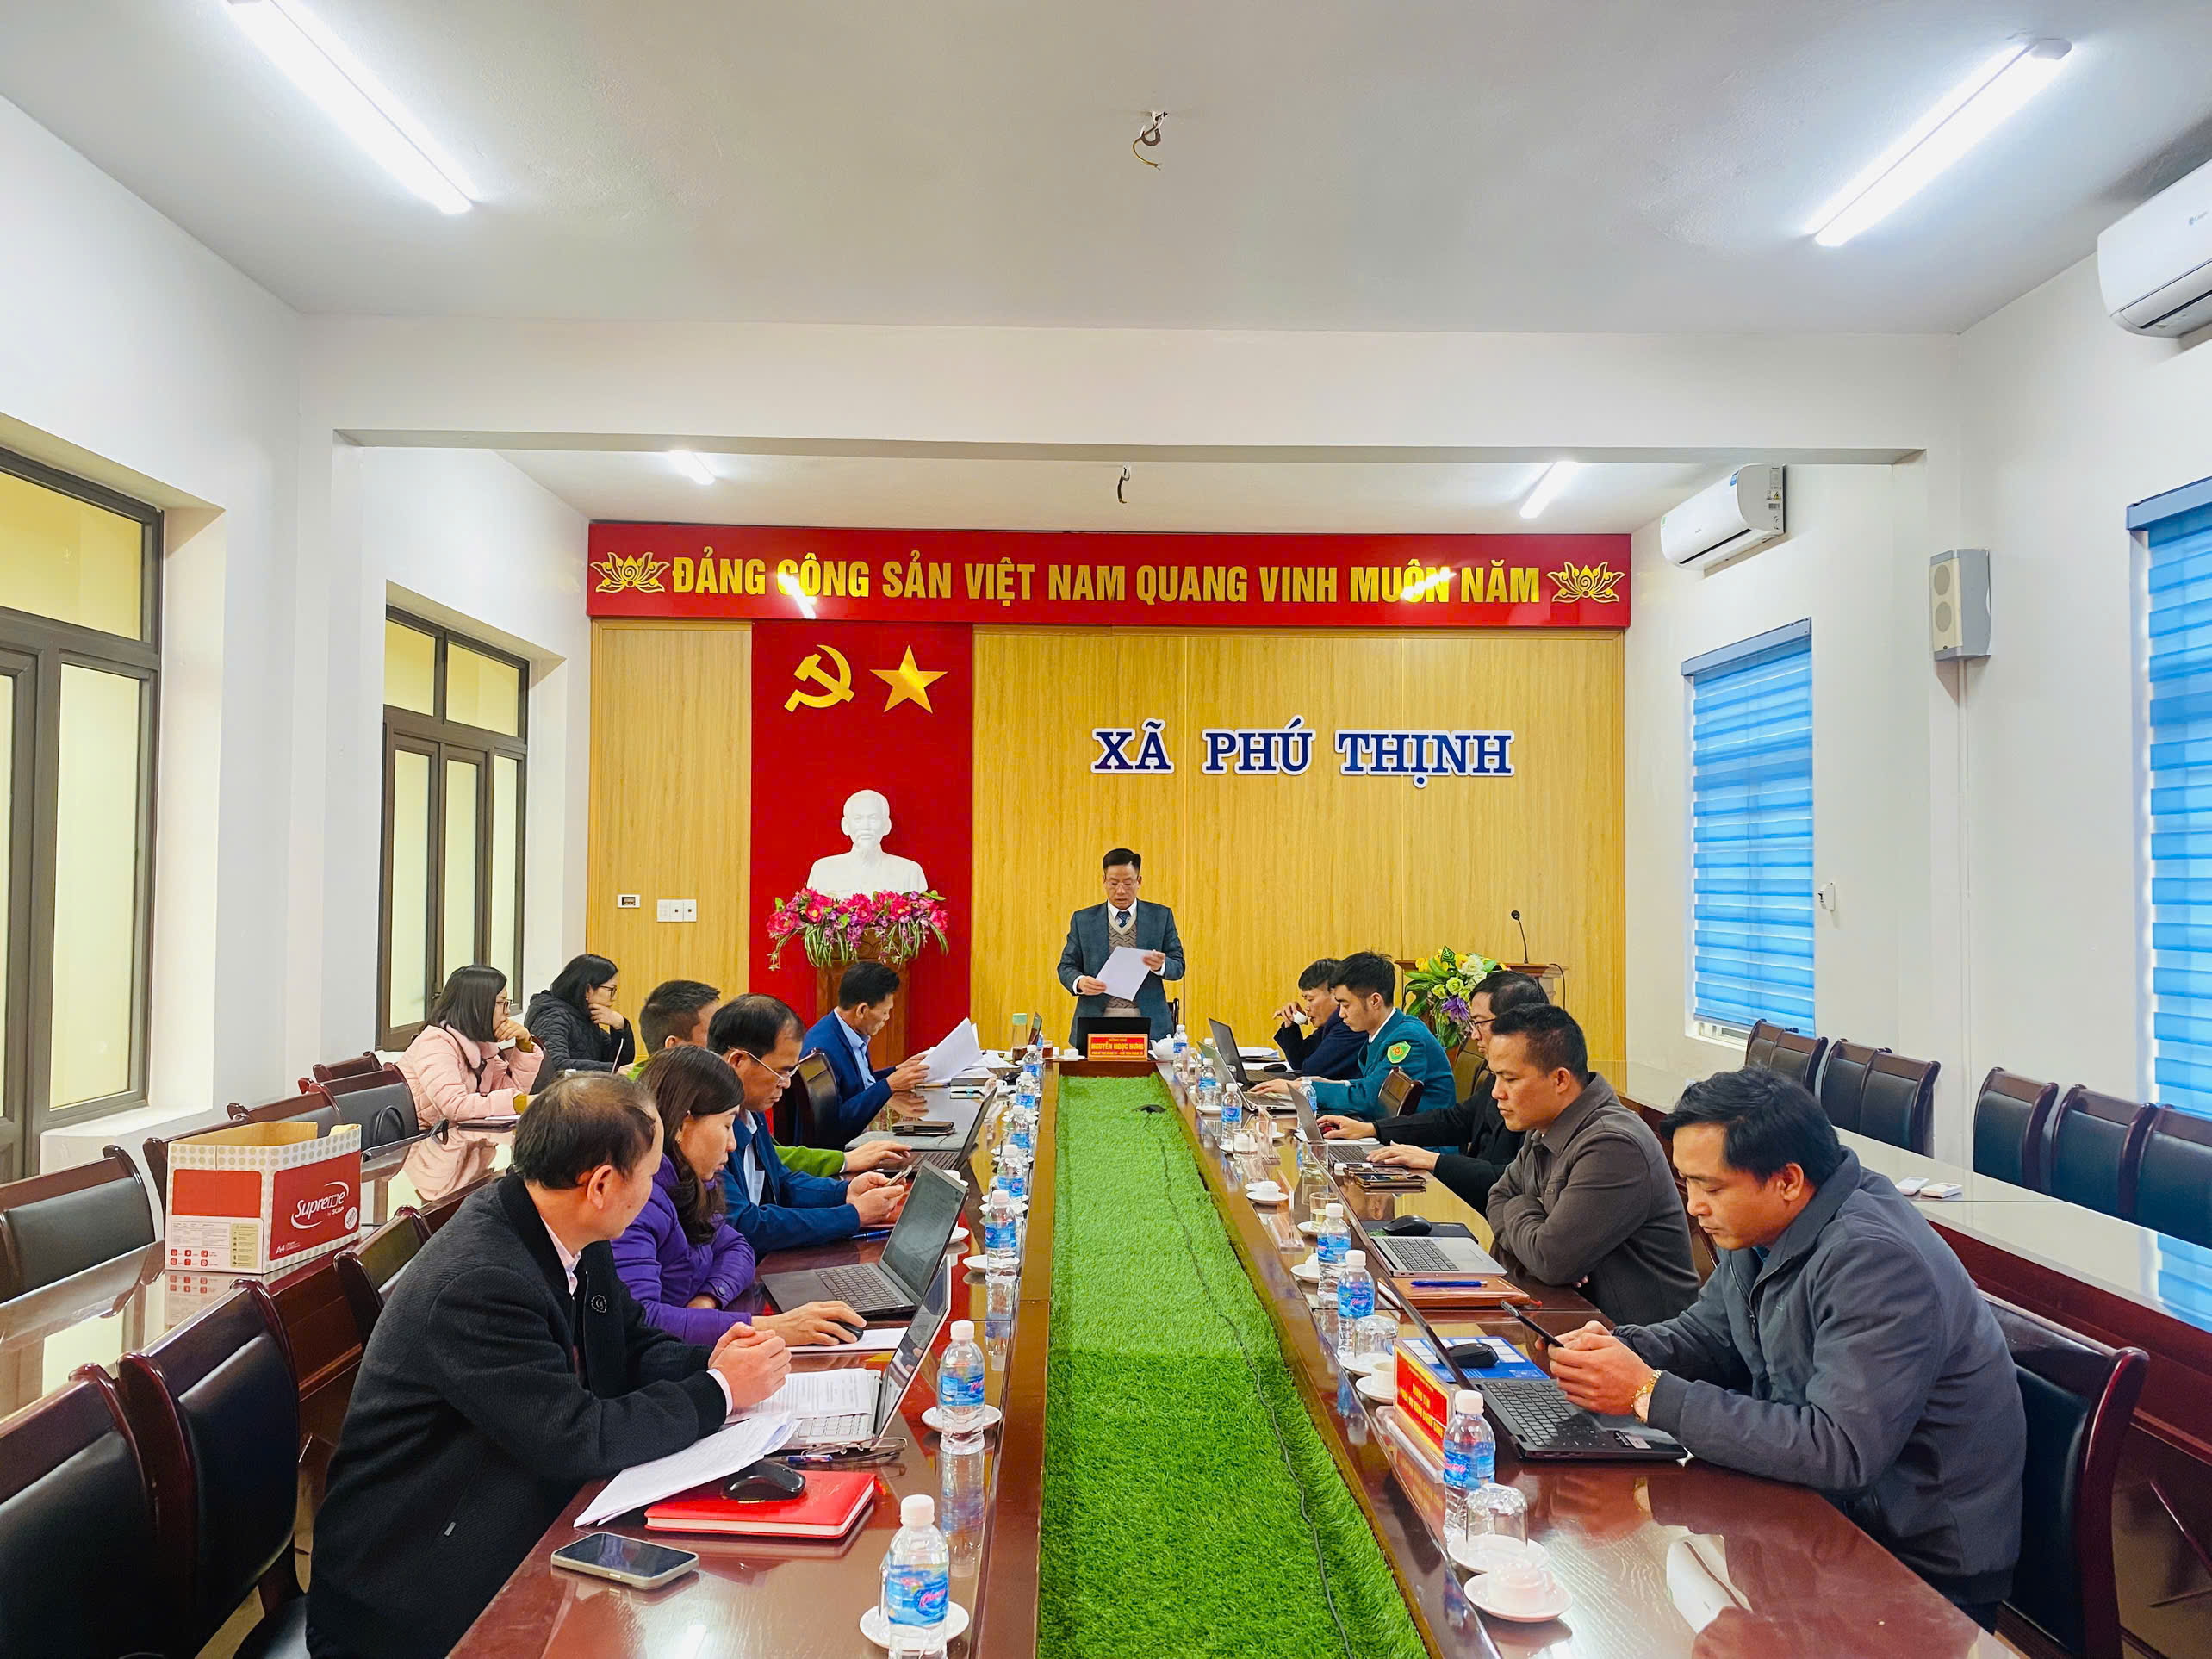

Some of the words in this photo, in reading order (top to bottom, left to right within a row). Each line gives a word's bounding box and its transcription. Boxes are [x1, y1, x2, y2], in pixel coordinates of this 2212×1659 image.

[672, 546, 765, 595] ĐẢNG
[882, 550, 952, 598] SẢN
[964, 557, 1035, 606] VIỆT
[1048, 564, 1125, 600] NAM
[1136, 565, 1248, 605] QUANG
[1260, 566, 1338, 602] VINH
[1350, 558, 1451, 603] MUÔN
[1460, 559, 1540, 603] NĂM
[1097, 721, 1171, 772] XÃ
[1203, 717, 1314, 774] PHÚ
[1337, 731, 1513, 786] THỊNH
[294, 1191, 345, 1220] Supreme
[275, 1244, 285, 1254] A4
